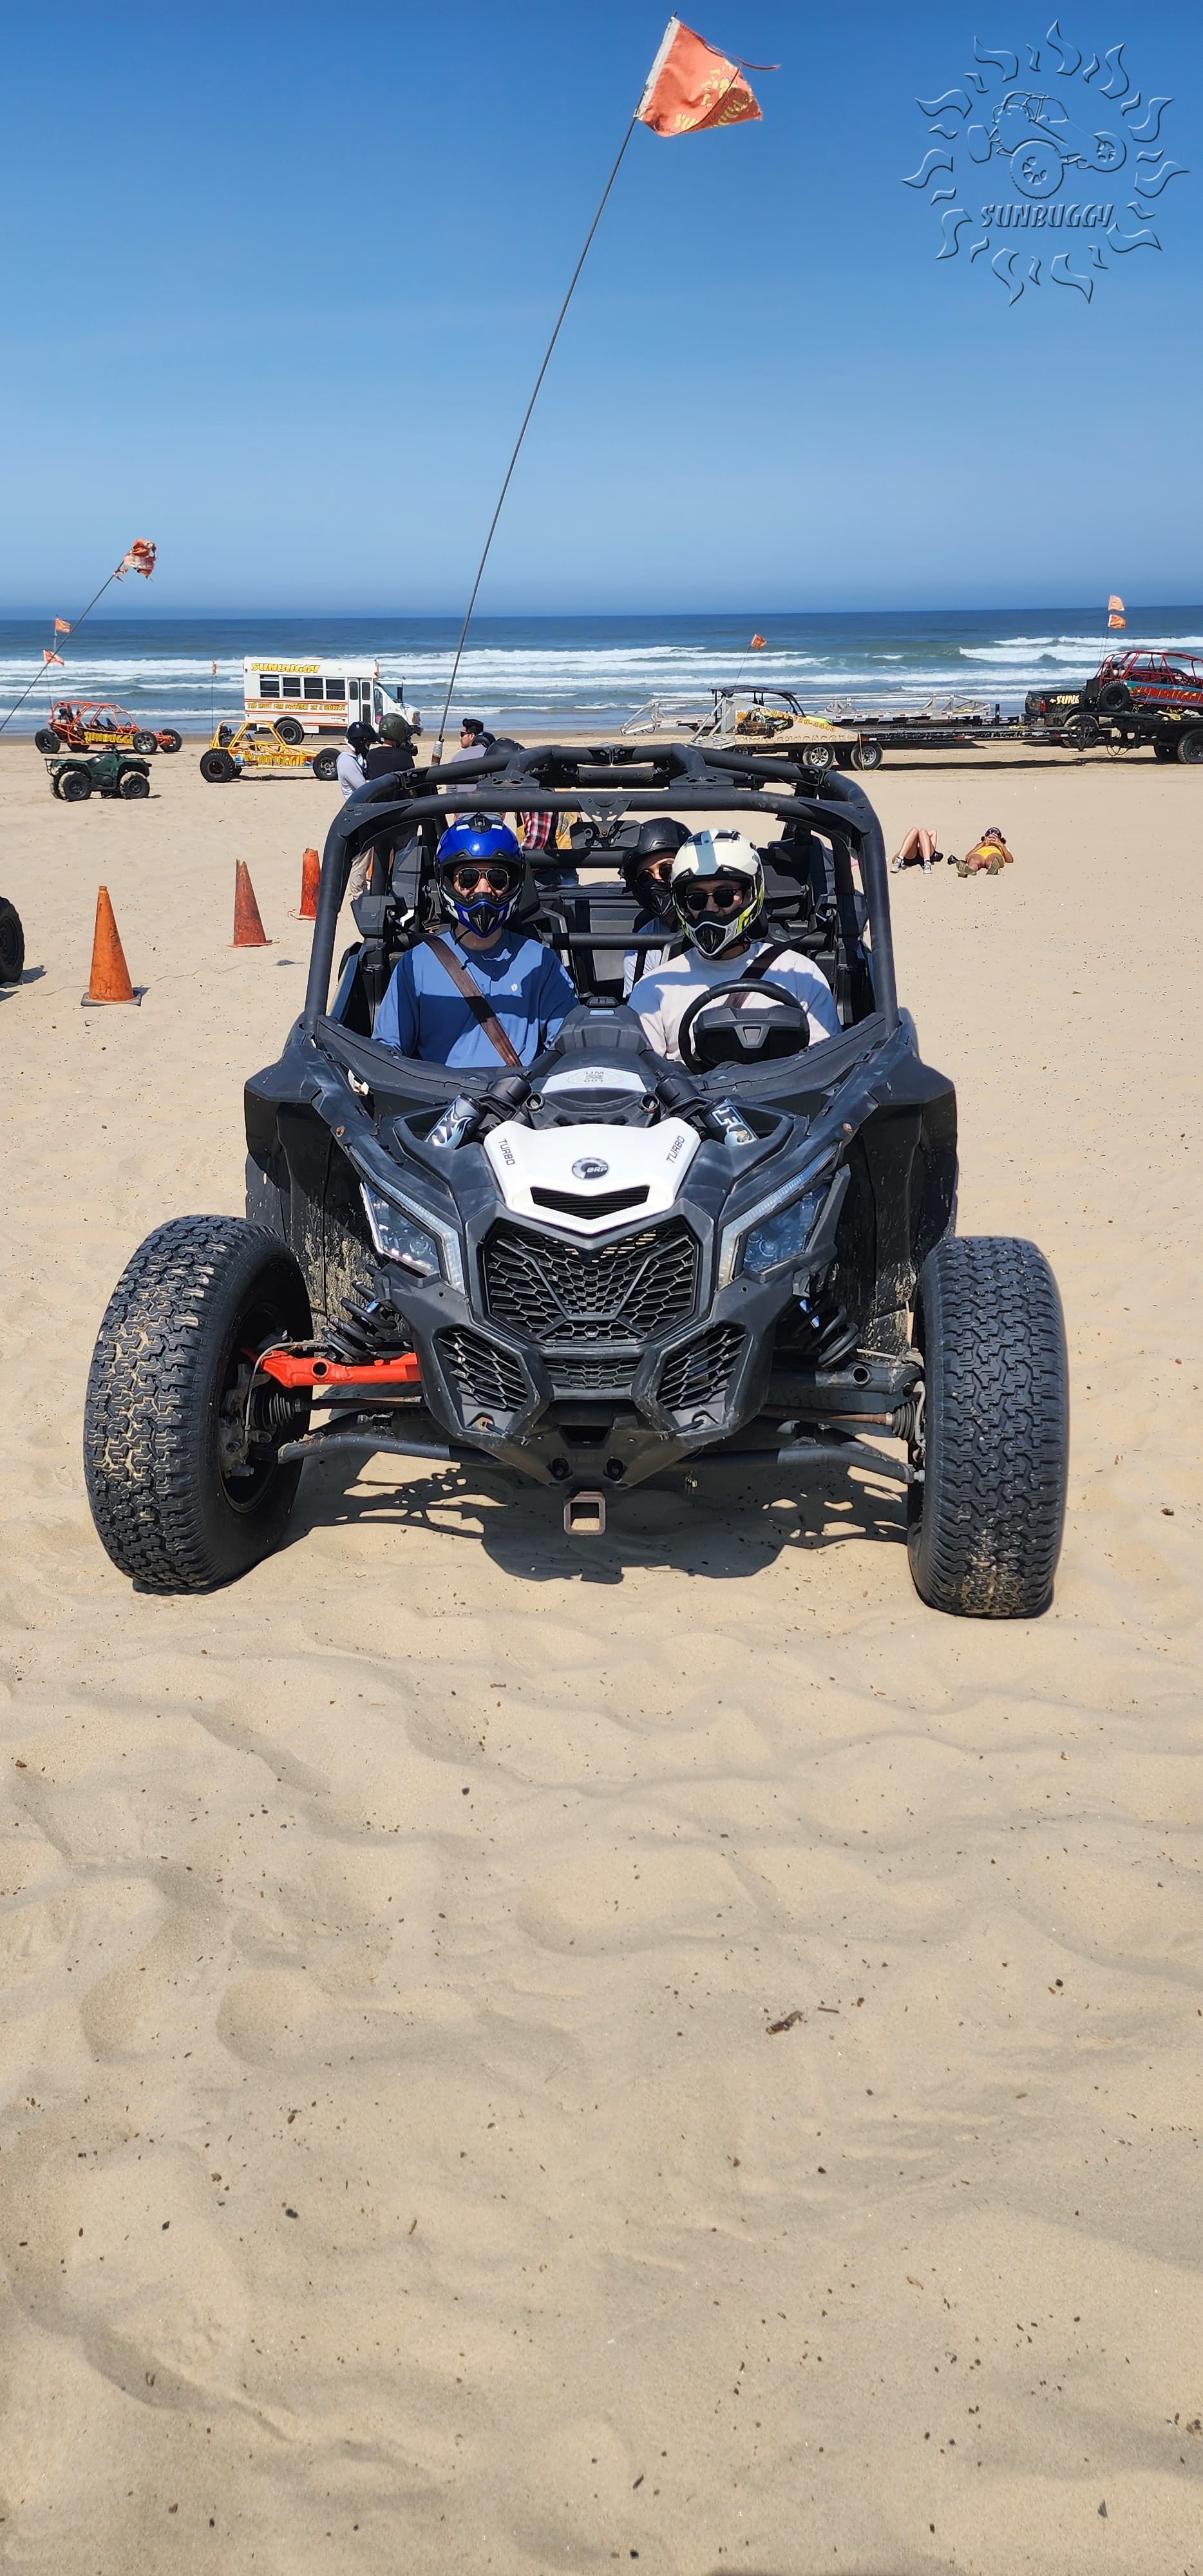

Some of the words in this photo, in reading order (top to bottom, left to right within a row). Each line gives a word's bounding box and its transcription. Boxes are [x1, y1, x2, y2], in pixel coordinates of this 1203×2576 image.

[251, 663, 321, 674] SUNBUGGY
[498, 1139, 516, 1166] TURBO
[666, 1135, 685, 1164] TURBO
